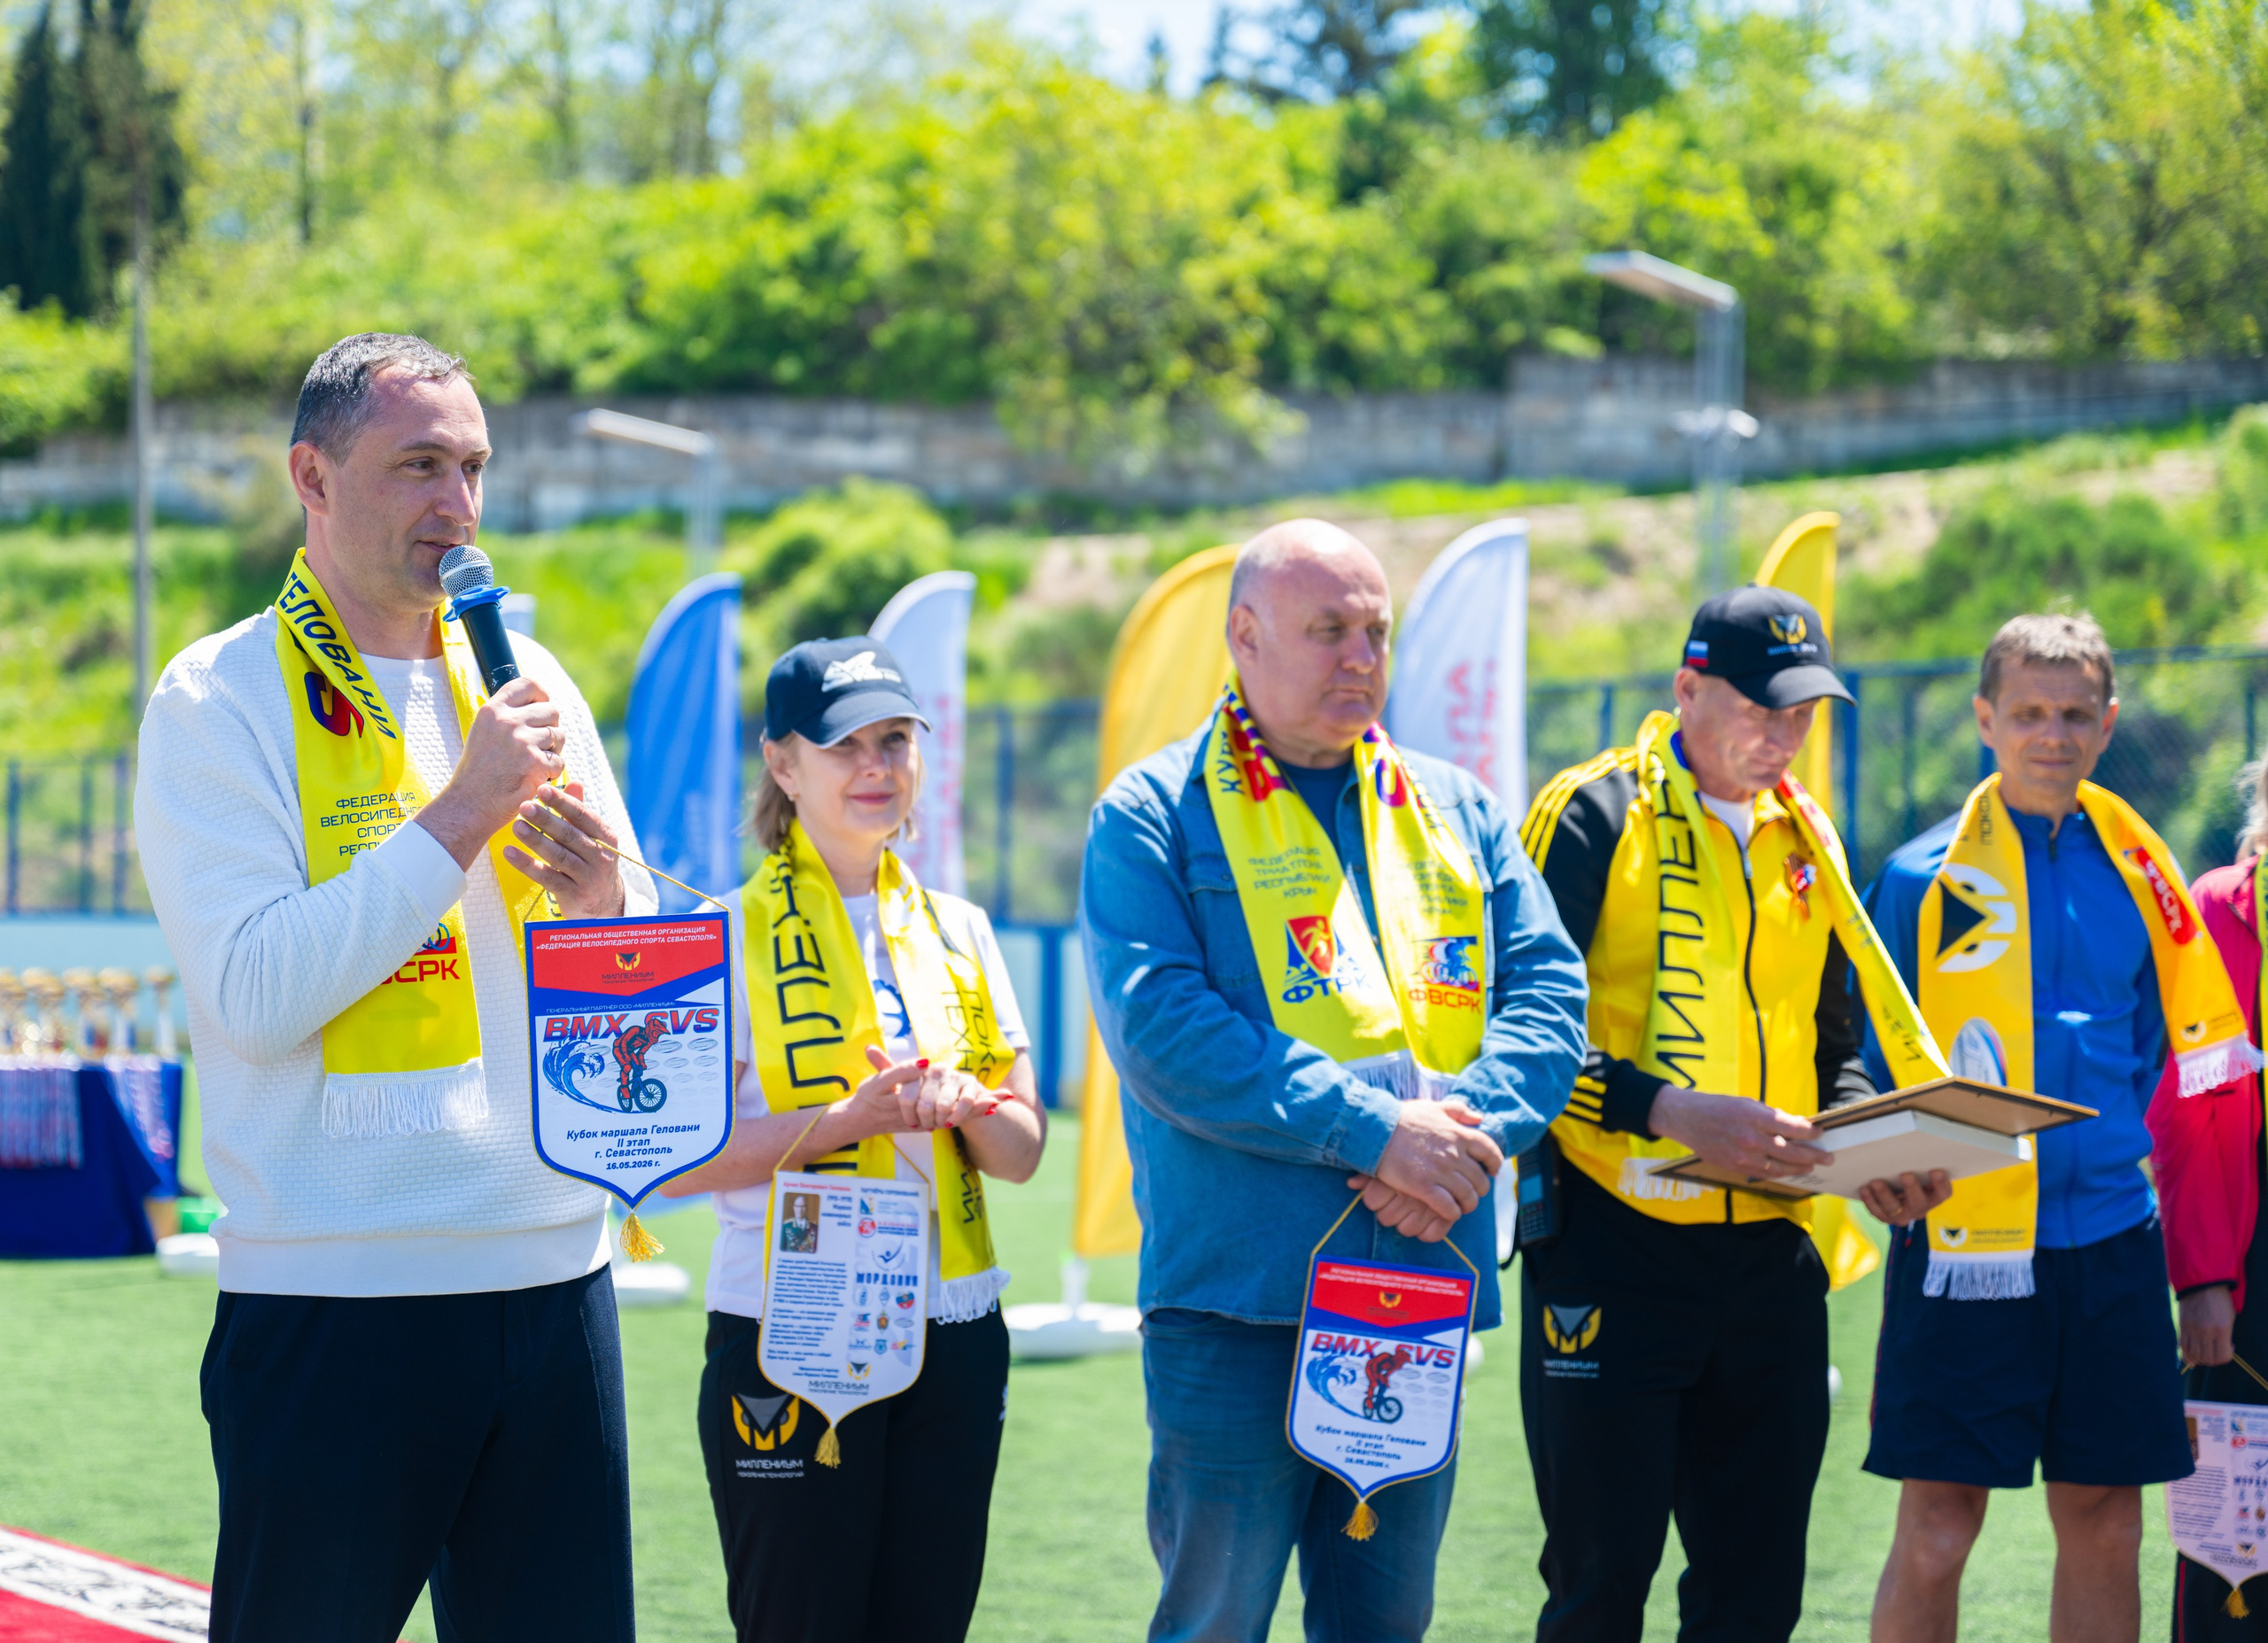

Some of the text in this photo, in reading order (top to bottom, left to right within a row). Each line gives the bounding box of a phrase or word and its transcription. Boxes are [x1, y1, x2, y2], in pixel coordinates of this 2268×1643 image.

[336, 792, 416, 809] ФЕДЕРАЦИЯ
[536, 934, 717, 950] «ФЕДЕРАЦИЯ ВЕЛОСИПЕДНОГО СПОРТА СЕВАСТОПОЛЯ»
[549, 926, 706, 942] РЕГИОНАЛЬНАЯ ОБЩЕСТВЕННАЯ ОРГАНИЗАЦИЯ
[380, 959, 461, 986] СРК
[602, 971, 655, 980] МИЛЛЕНИУМ
[1409, 988, 1481, 1014] ФВСРК
[543, 1013, 630, 1042] BMX
[566, 1124, 700, 1142] Кубок маршала Геловани
[617, 1138, 650, 1148] II этап
[605, 1146, 673, 1158] Севастополь
[606, 1159, 653, 1170] 16.05.2026
[1310, 1333, 1382, 1359] BMX
